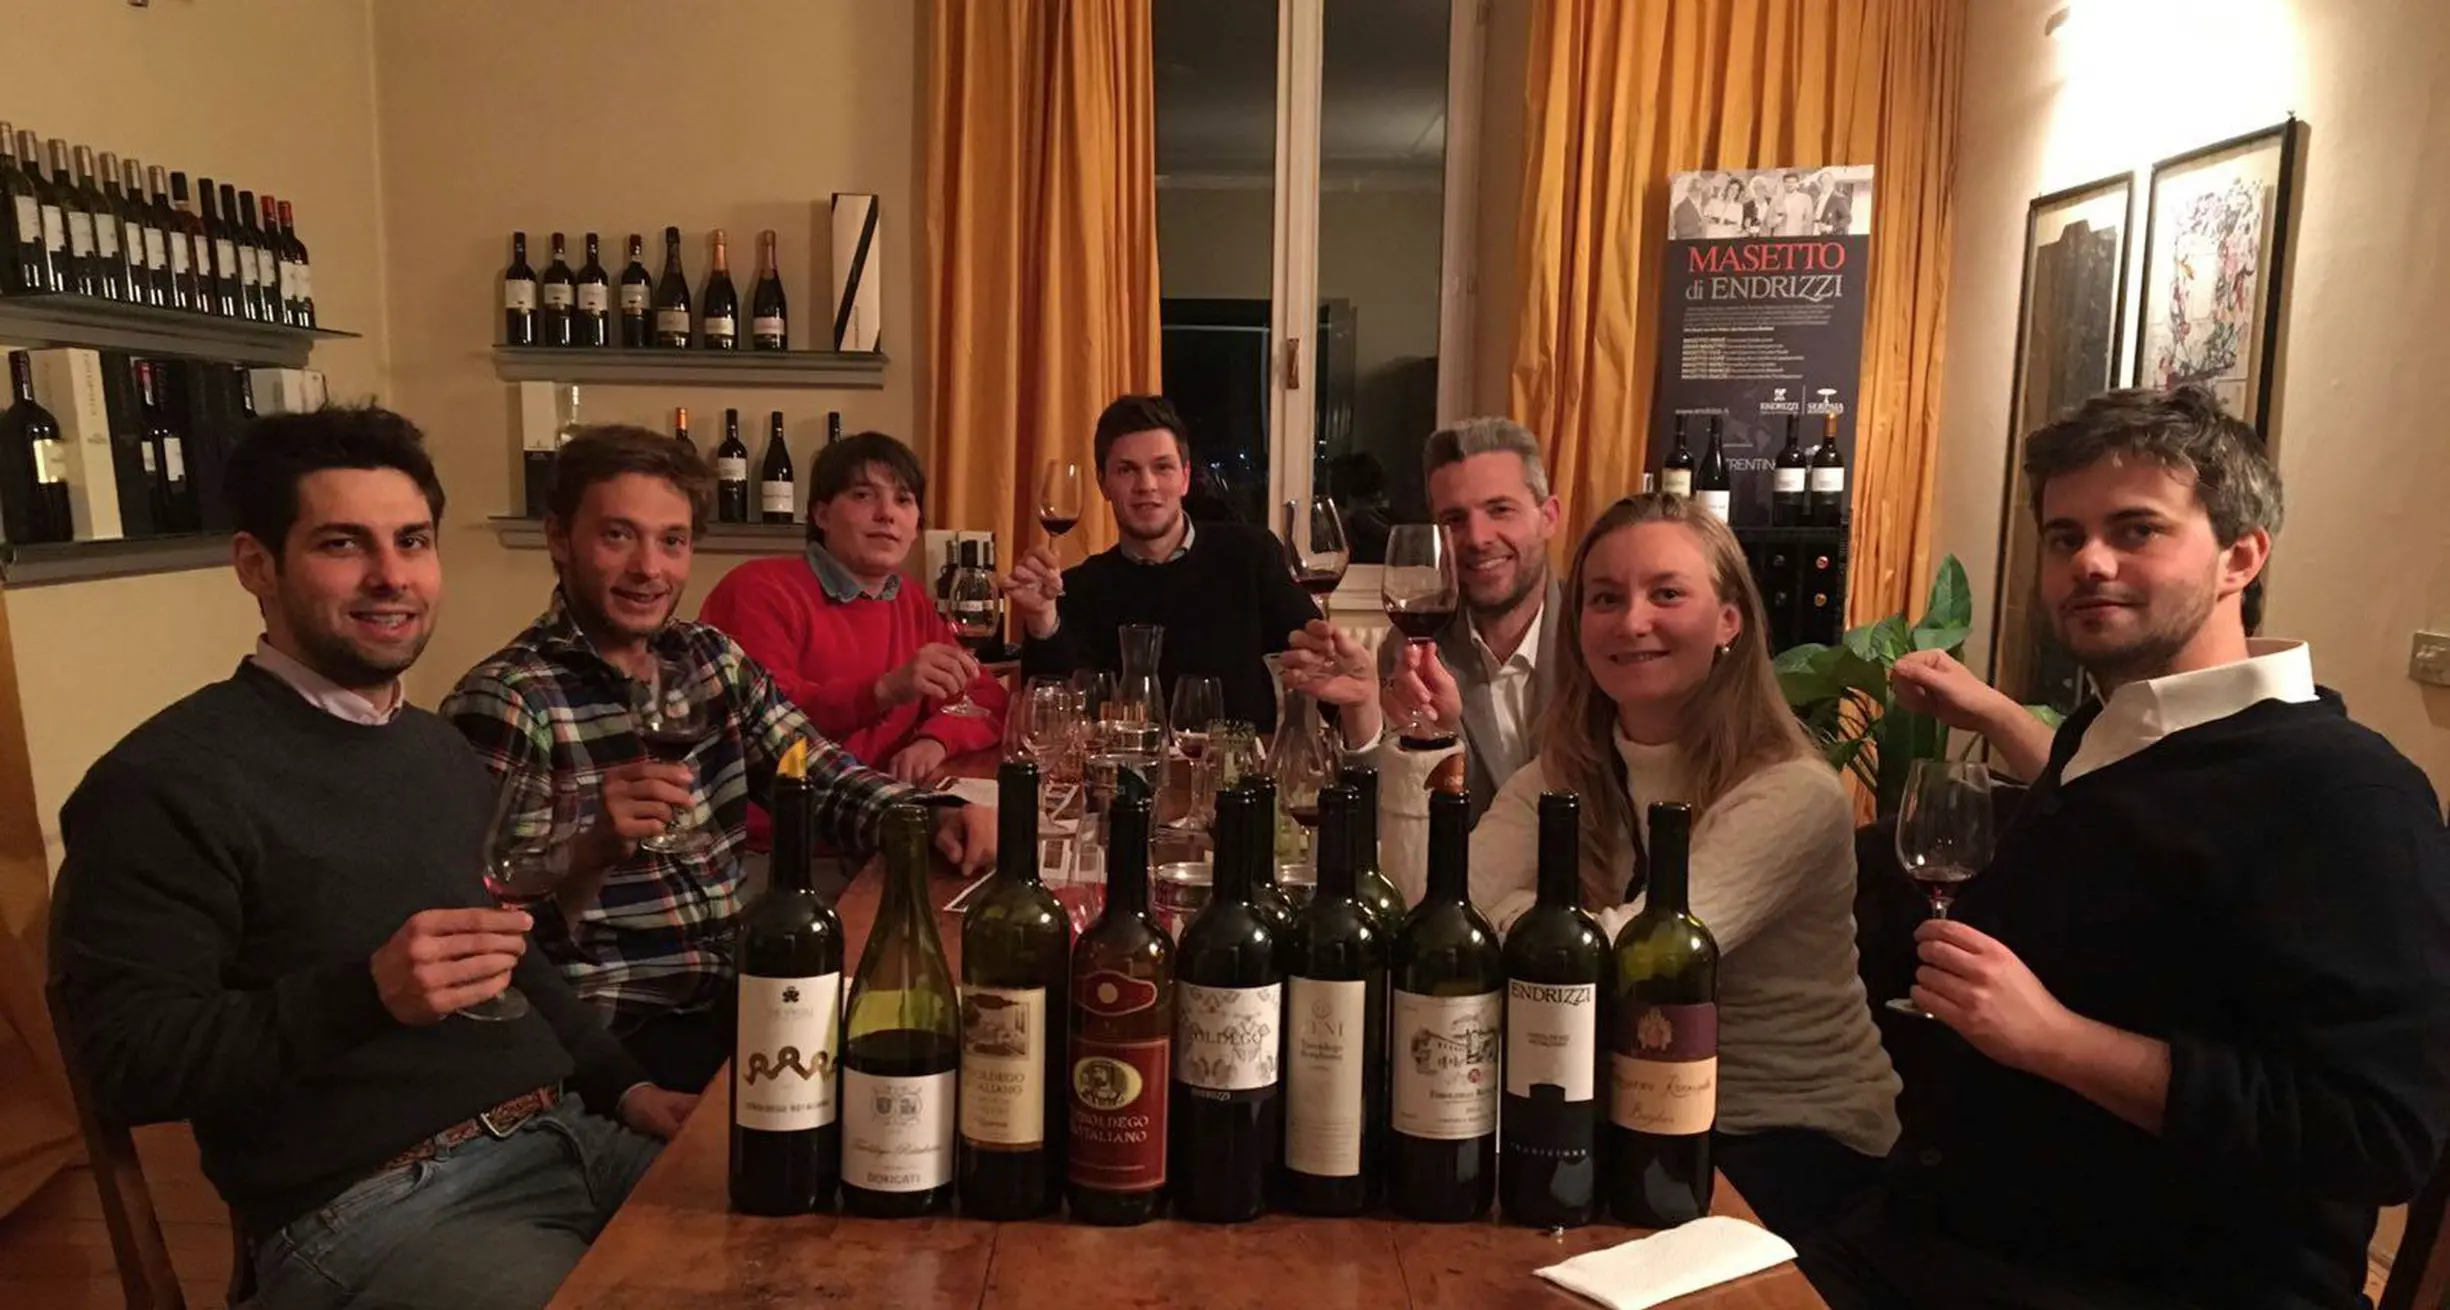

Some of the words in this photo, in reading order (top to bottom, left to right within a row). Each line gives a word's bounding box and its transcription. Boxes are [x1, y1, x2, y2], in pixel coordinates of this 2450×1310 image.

[1688, 243, 1844, 274] MASETTO
[1685, 280, 1703, 300] di
[1711, 274, 1842, 302] ENDRIZZI
[1725, 457, 1777, 472] TRENTIN
[1510, 983, 1592, 1007] ENDRIZZI
